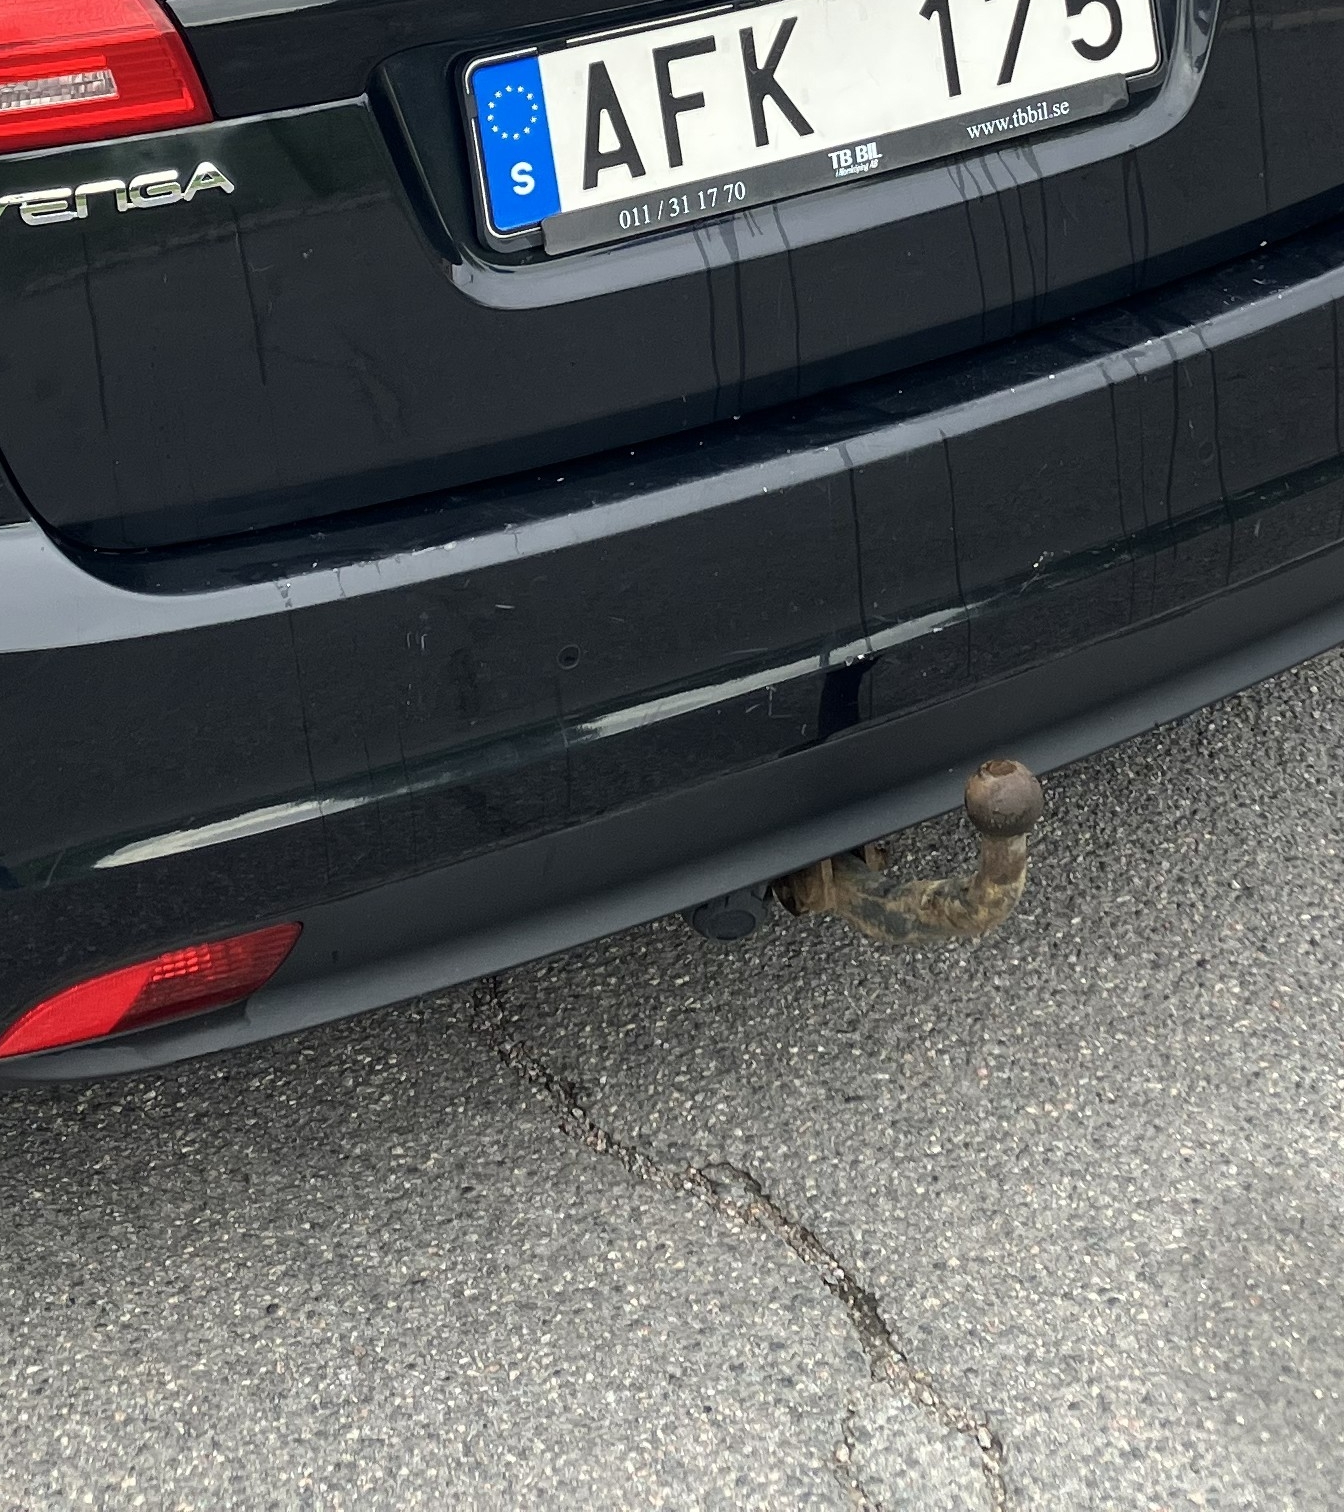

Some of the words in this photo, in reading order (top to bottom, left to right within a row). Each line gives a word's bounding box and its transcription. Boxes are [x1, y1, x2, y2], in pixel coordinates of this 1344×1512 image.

[582, 16, 815, 191] AFK
[966, 101, 1070, 139] www.tbbil.se
[828, 149, 853, 169] TB
[855, 142, 883, 163] BIL
[511, 162, 535, 196] S
[619, 204, 650, 229] 011
[658, 200, 664, 220] /
[669, 195, 690, 217] 31
[698, 187, 718, 210] 17
[723, 181, 746, 203] 70
